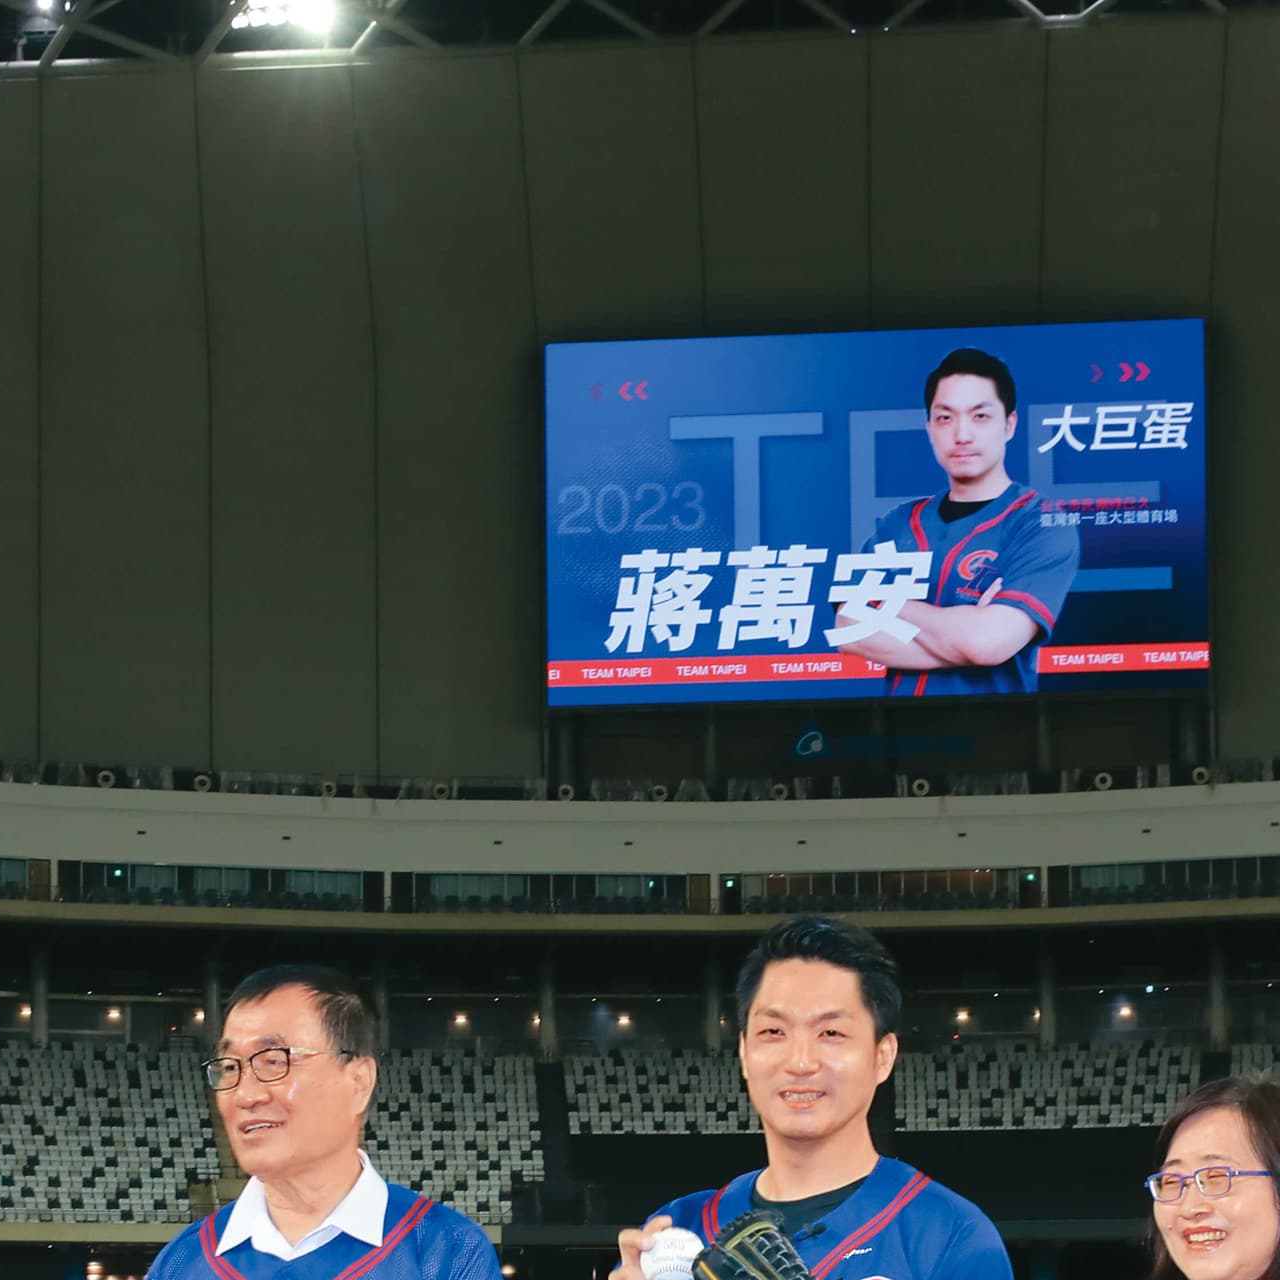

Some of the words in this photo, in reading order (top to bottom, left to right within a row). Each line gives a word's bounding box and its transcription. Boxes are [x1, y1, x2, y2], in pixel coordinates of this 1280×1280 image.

[1038, 402, 1194, 453] 大巨蛋
[558, 481, 705, 534] 2023
[603, 540, 933, 653] 蔣萬安
[581, 668, 614, 679] TEAM
[616, 667, 652, 678] TAIPEI
[676, 665, 710, 676] TEAM
[711, 664, 747, 675] TAIPEI
[771, 662, 804, 674] TEAM
[806, 661, 842, 673] TAIPEI
[1052, 654, 1085, 666] TEAM
[1087, 653, 1124, 664] TAIPEI
[1143, 652, 1177, 663] TEAM
